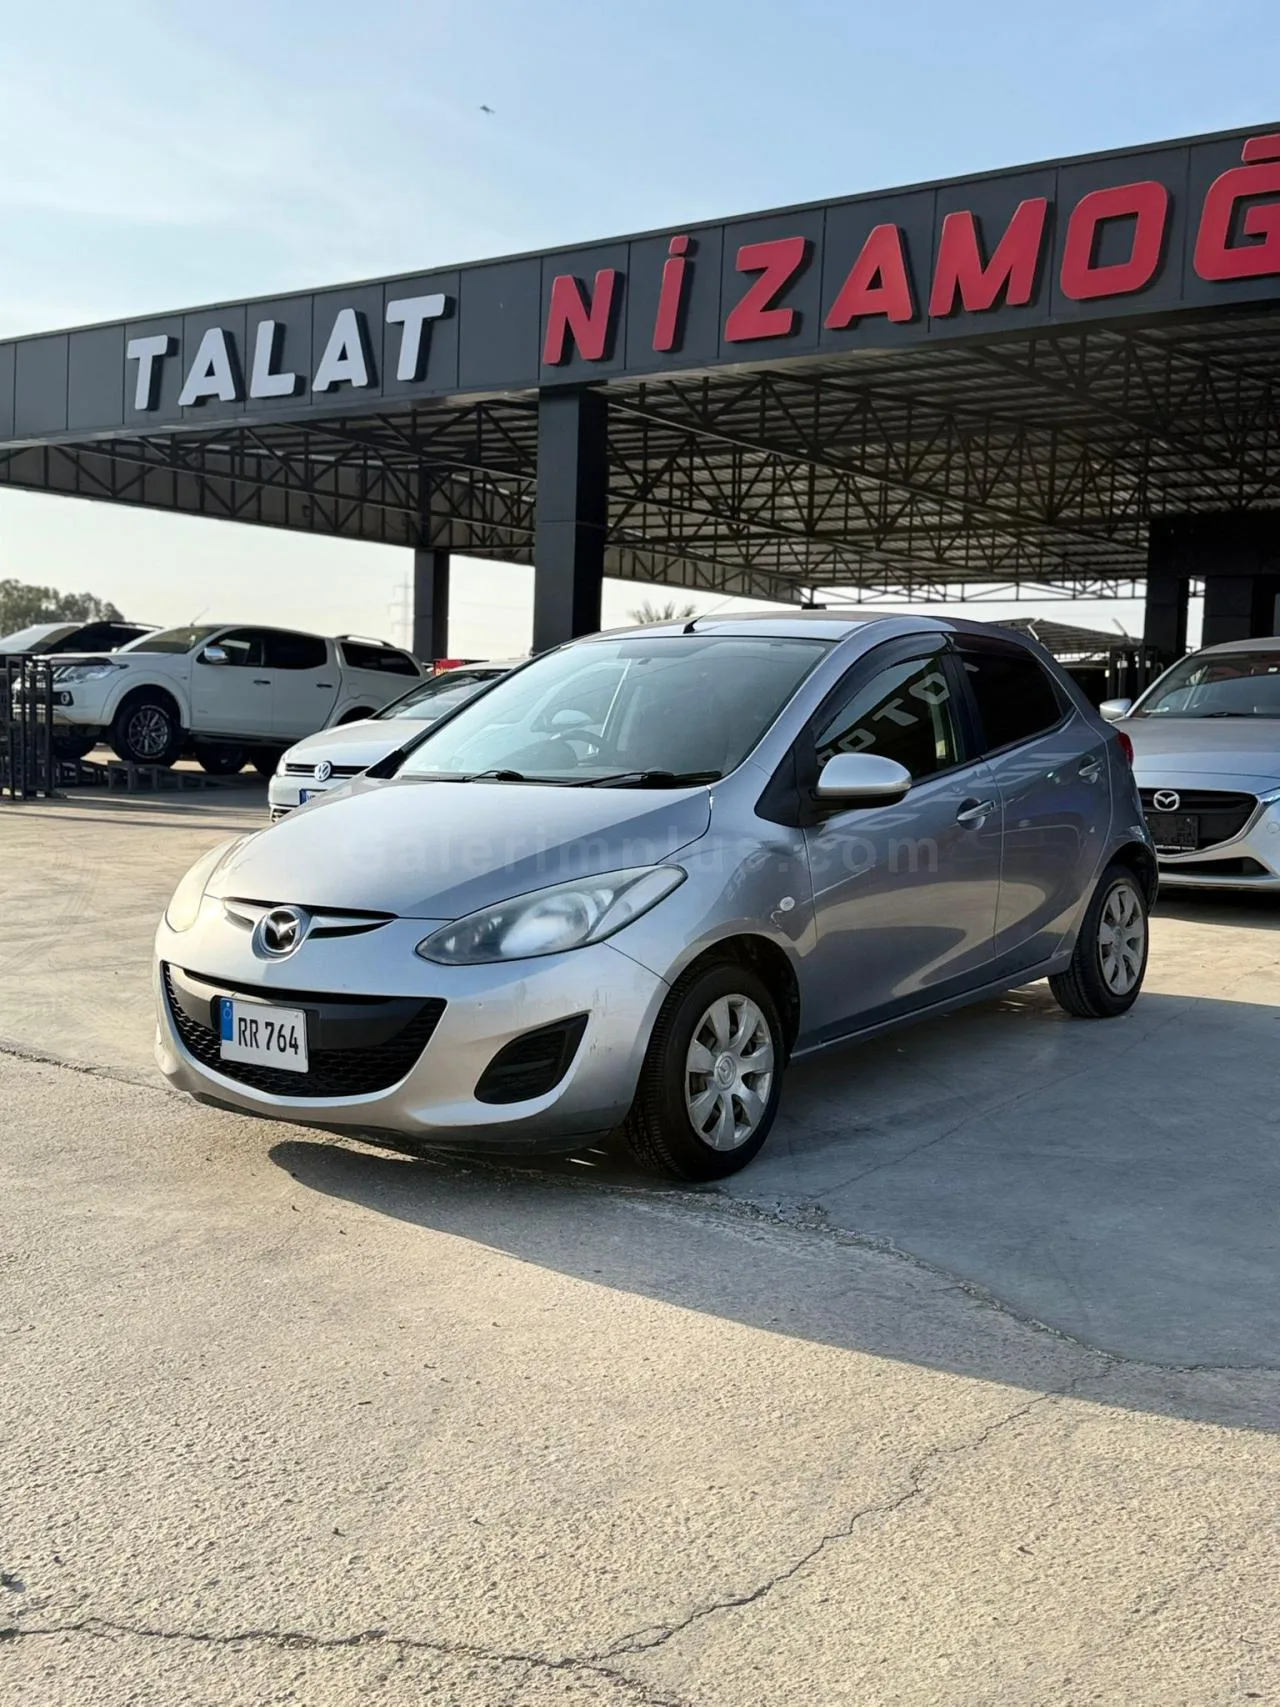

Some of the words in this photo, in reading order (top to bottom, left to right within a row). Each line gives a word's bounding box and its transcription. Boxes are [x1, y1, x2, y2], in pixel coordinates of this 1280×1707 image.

[127, 293, 448, 411] TALAT
[238, 1017, 259, 1049] RR
[265, 1021, 299, 1055] 764
